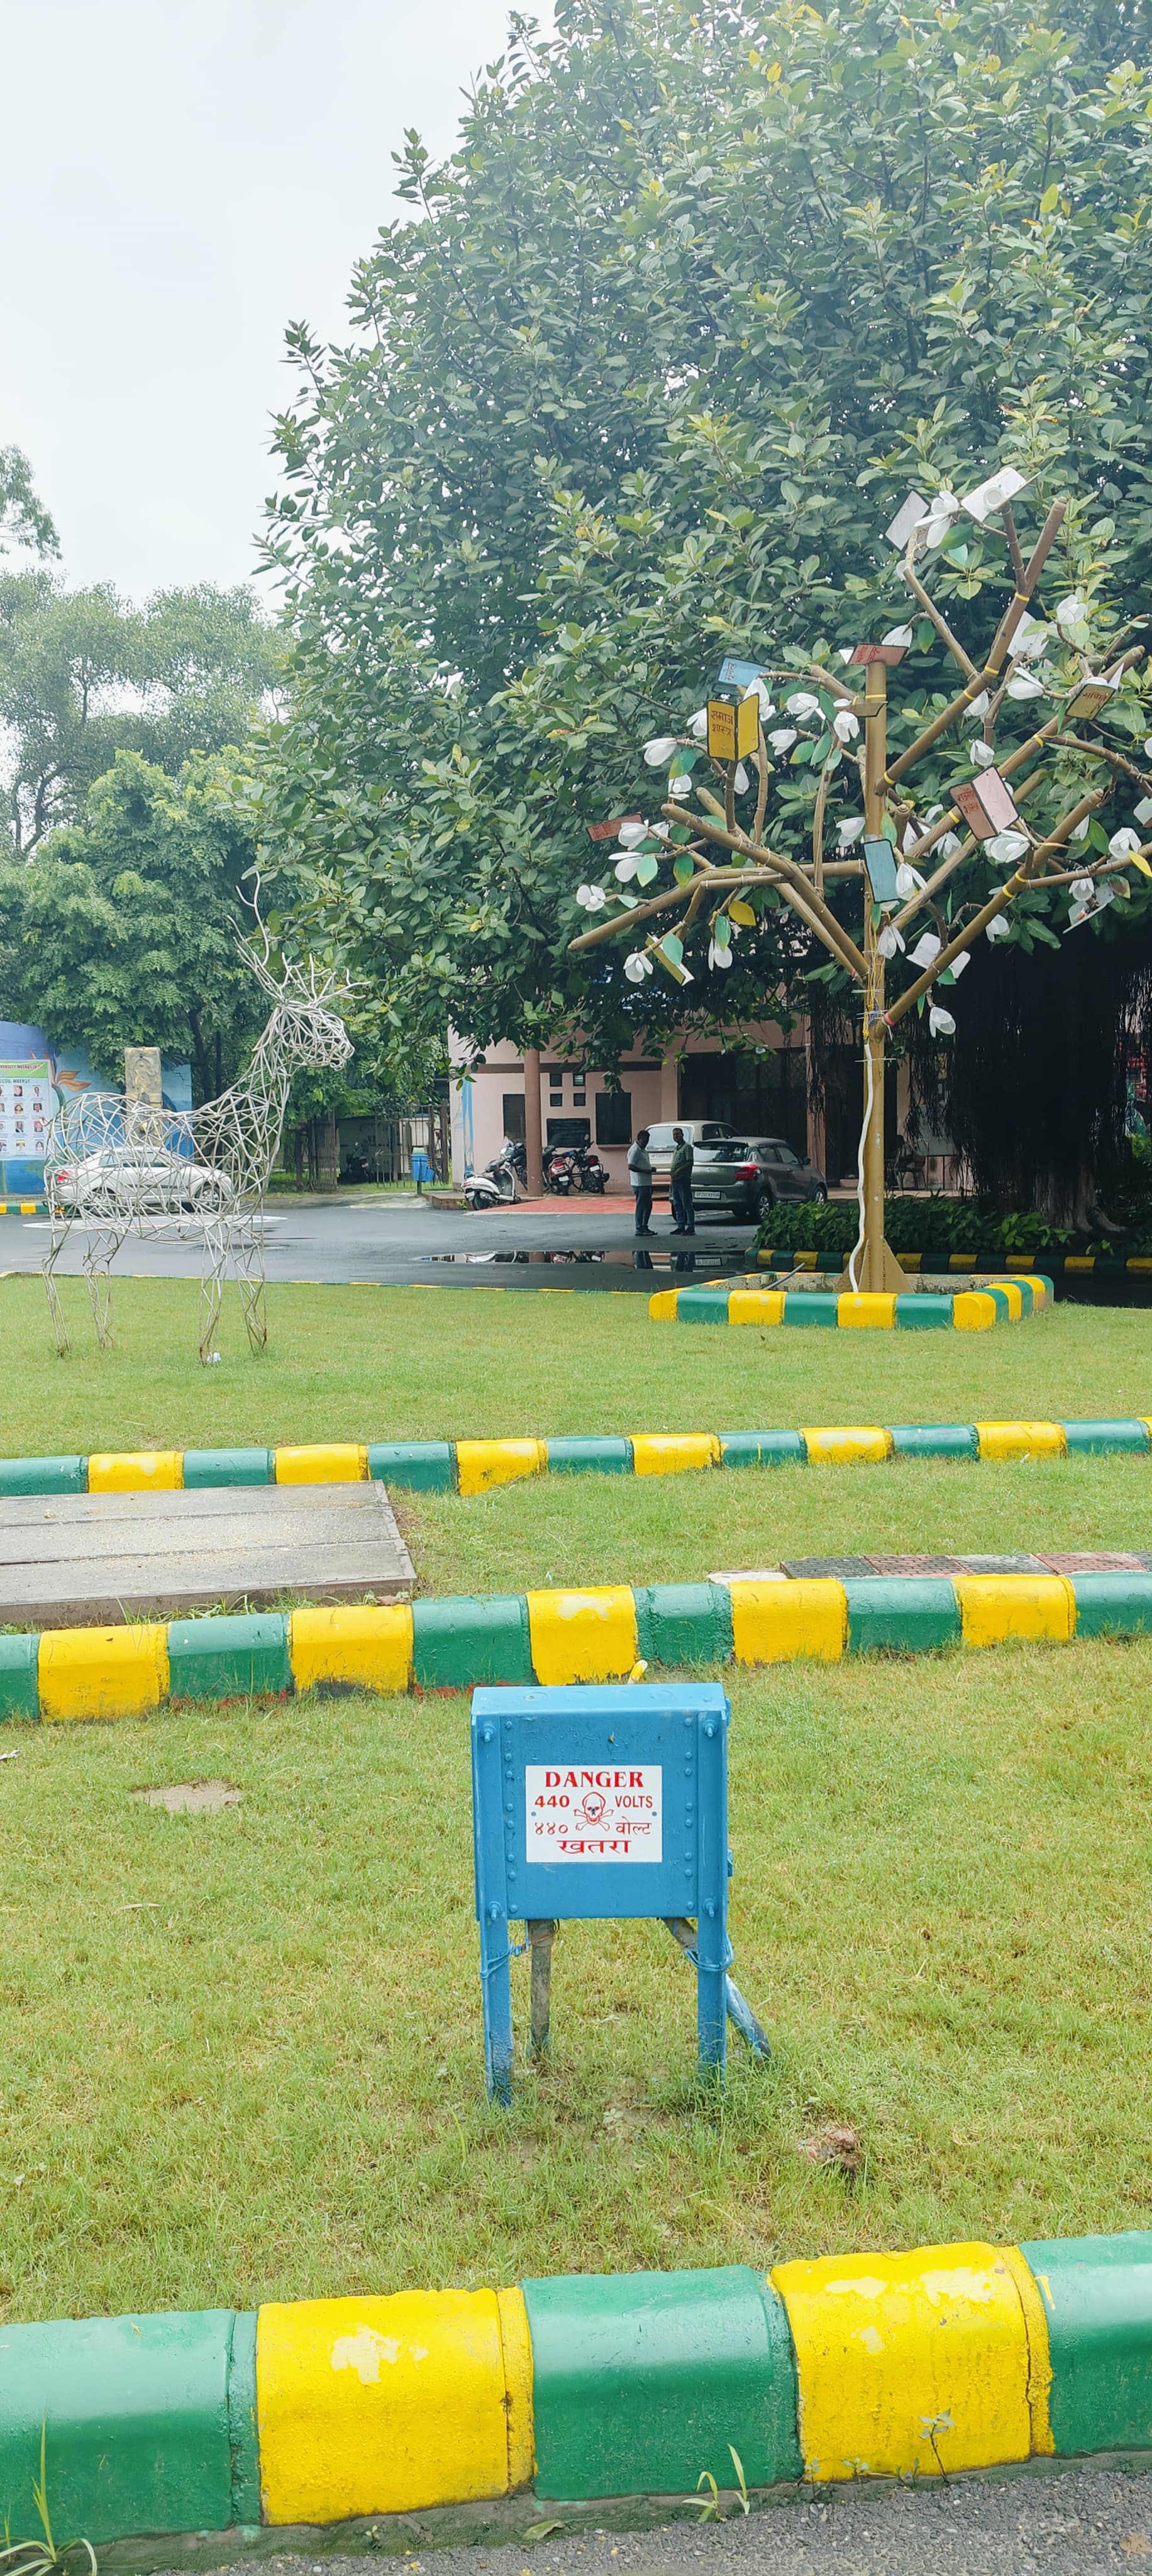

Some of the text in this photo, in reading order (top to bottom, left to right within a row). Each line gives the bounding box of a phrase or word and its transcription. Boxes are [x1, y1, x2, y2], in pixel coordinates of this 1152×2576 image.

[711, 710, 733, 725] समाज
[711, 724, 731, 736] शास्त्र
[545, 1771, 644, 1787] DANGER
[534, 1795, 653, 1809] 440 VOLTS
[534, 1816, 652, 1836] ४४० वोल्ट
[557, 1840, 631, 1854] खतरा
